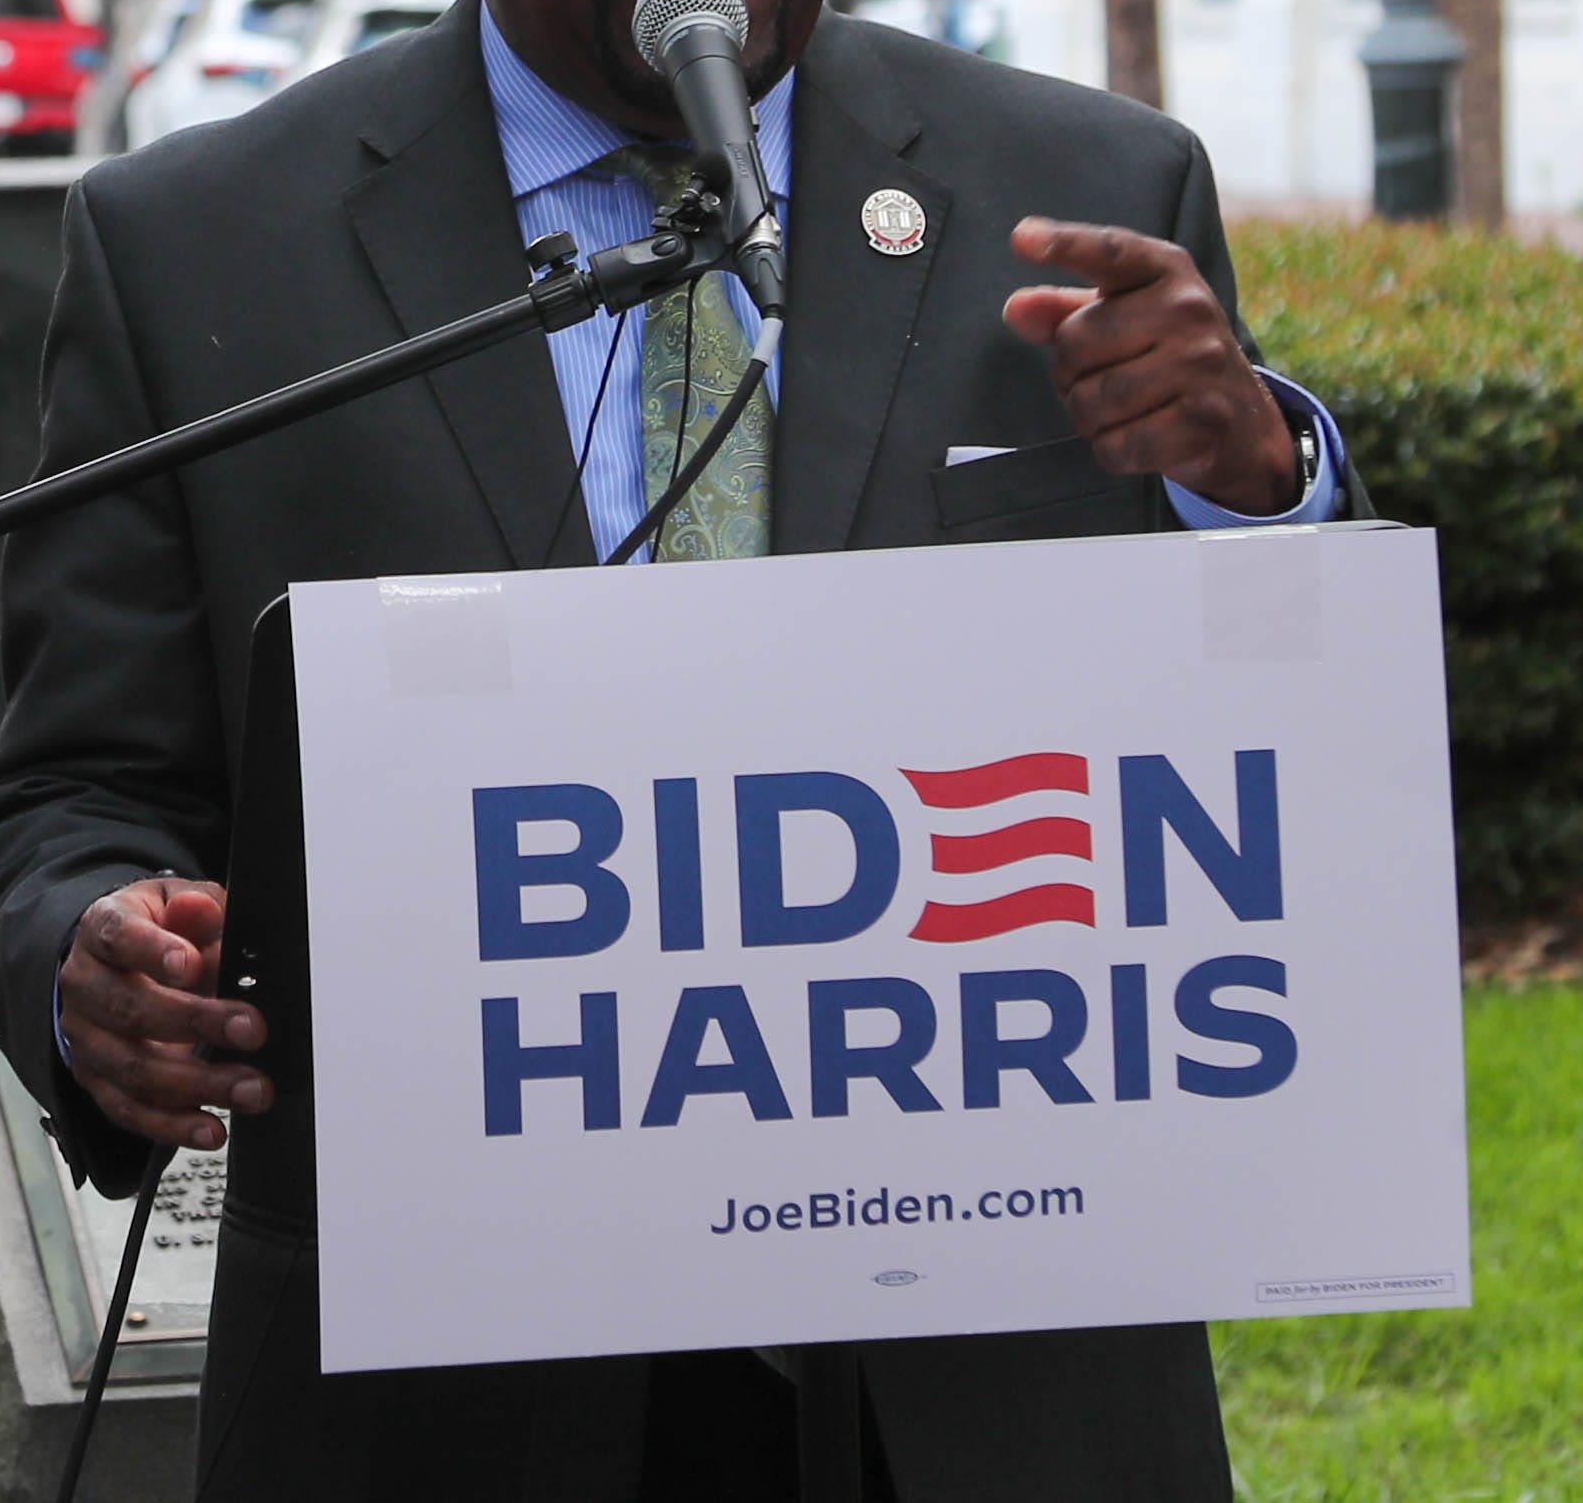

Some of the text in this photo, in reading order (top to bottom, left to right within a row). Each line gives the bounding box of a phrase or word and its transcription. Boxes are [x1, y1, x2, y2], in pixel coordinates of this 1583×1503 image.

[472, 748, 1285, 962] BIDEN
[481, 955, 1298, 1138] HARRIS
[711, 1186, 1084, 1235] JoeBiden.com
[1266, 1286, 1291, 1296] PAID
[1323, 1283, 1356, 1293] BIDEN
[1359, 1281, 1381, 1291] FOR
[1383, 1278, 1443, 1289] PRESIDENT
